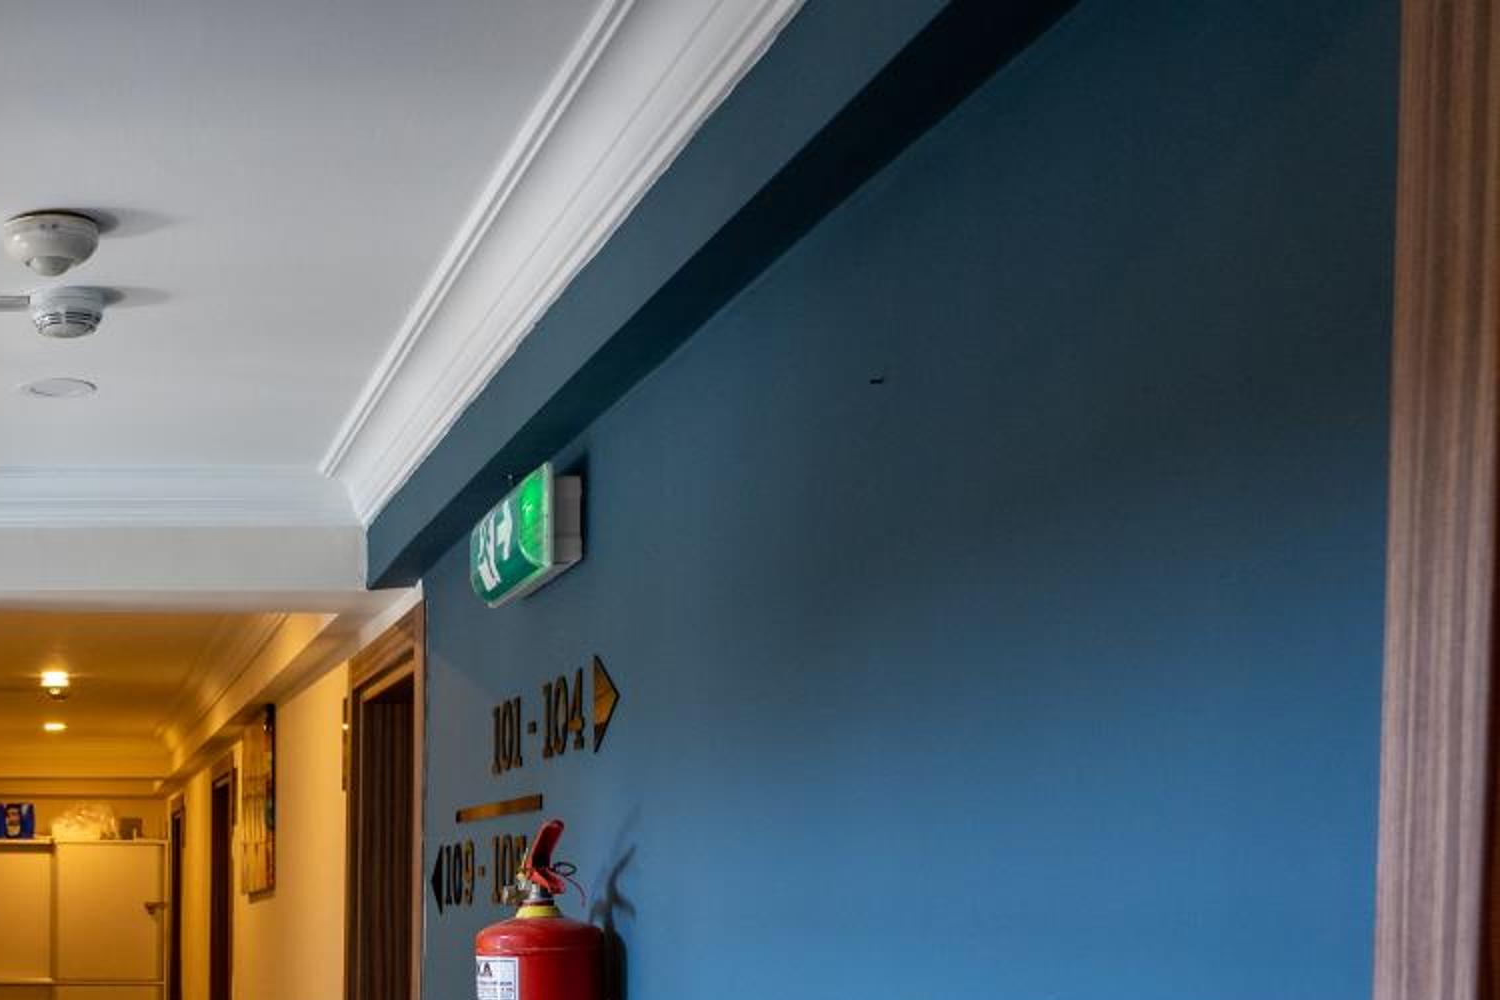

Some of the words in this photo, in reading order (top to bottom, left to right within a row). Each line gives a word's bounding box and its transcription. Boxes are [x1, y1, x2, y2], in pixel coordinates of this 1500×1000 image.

[492, 696, 523, 775] 101
[543, 666, 585, 760] 104
[445, 838, 475, 906] 109
